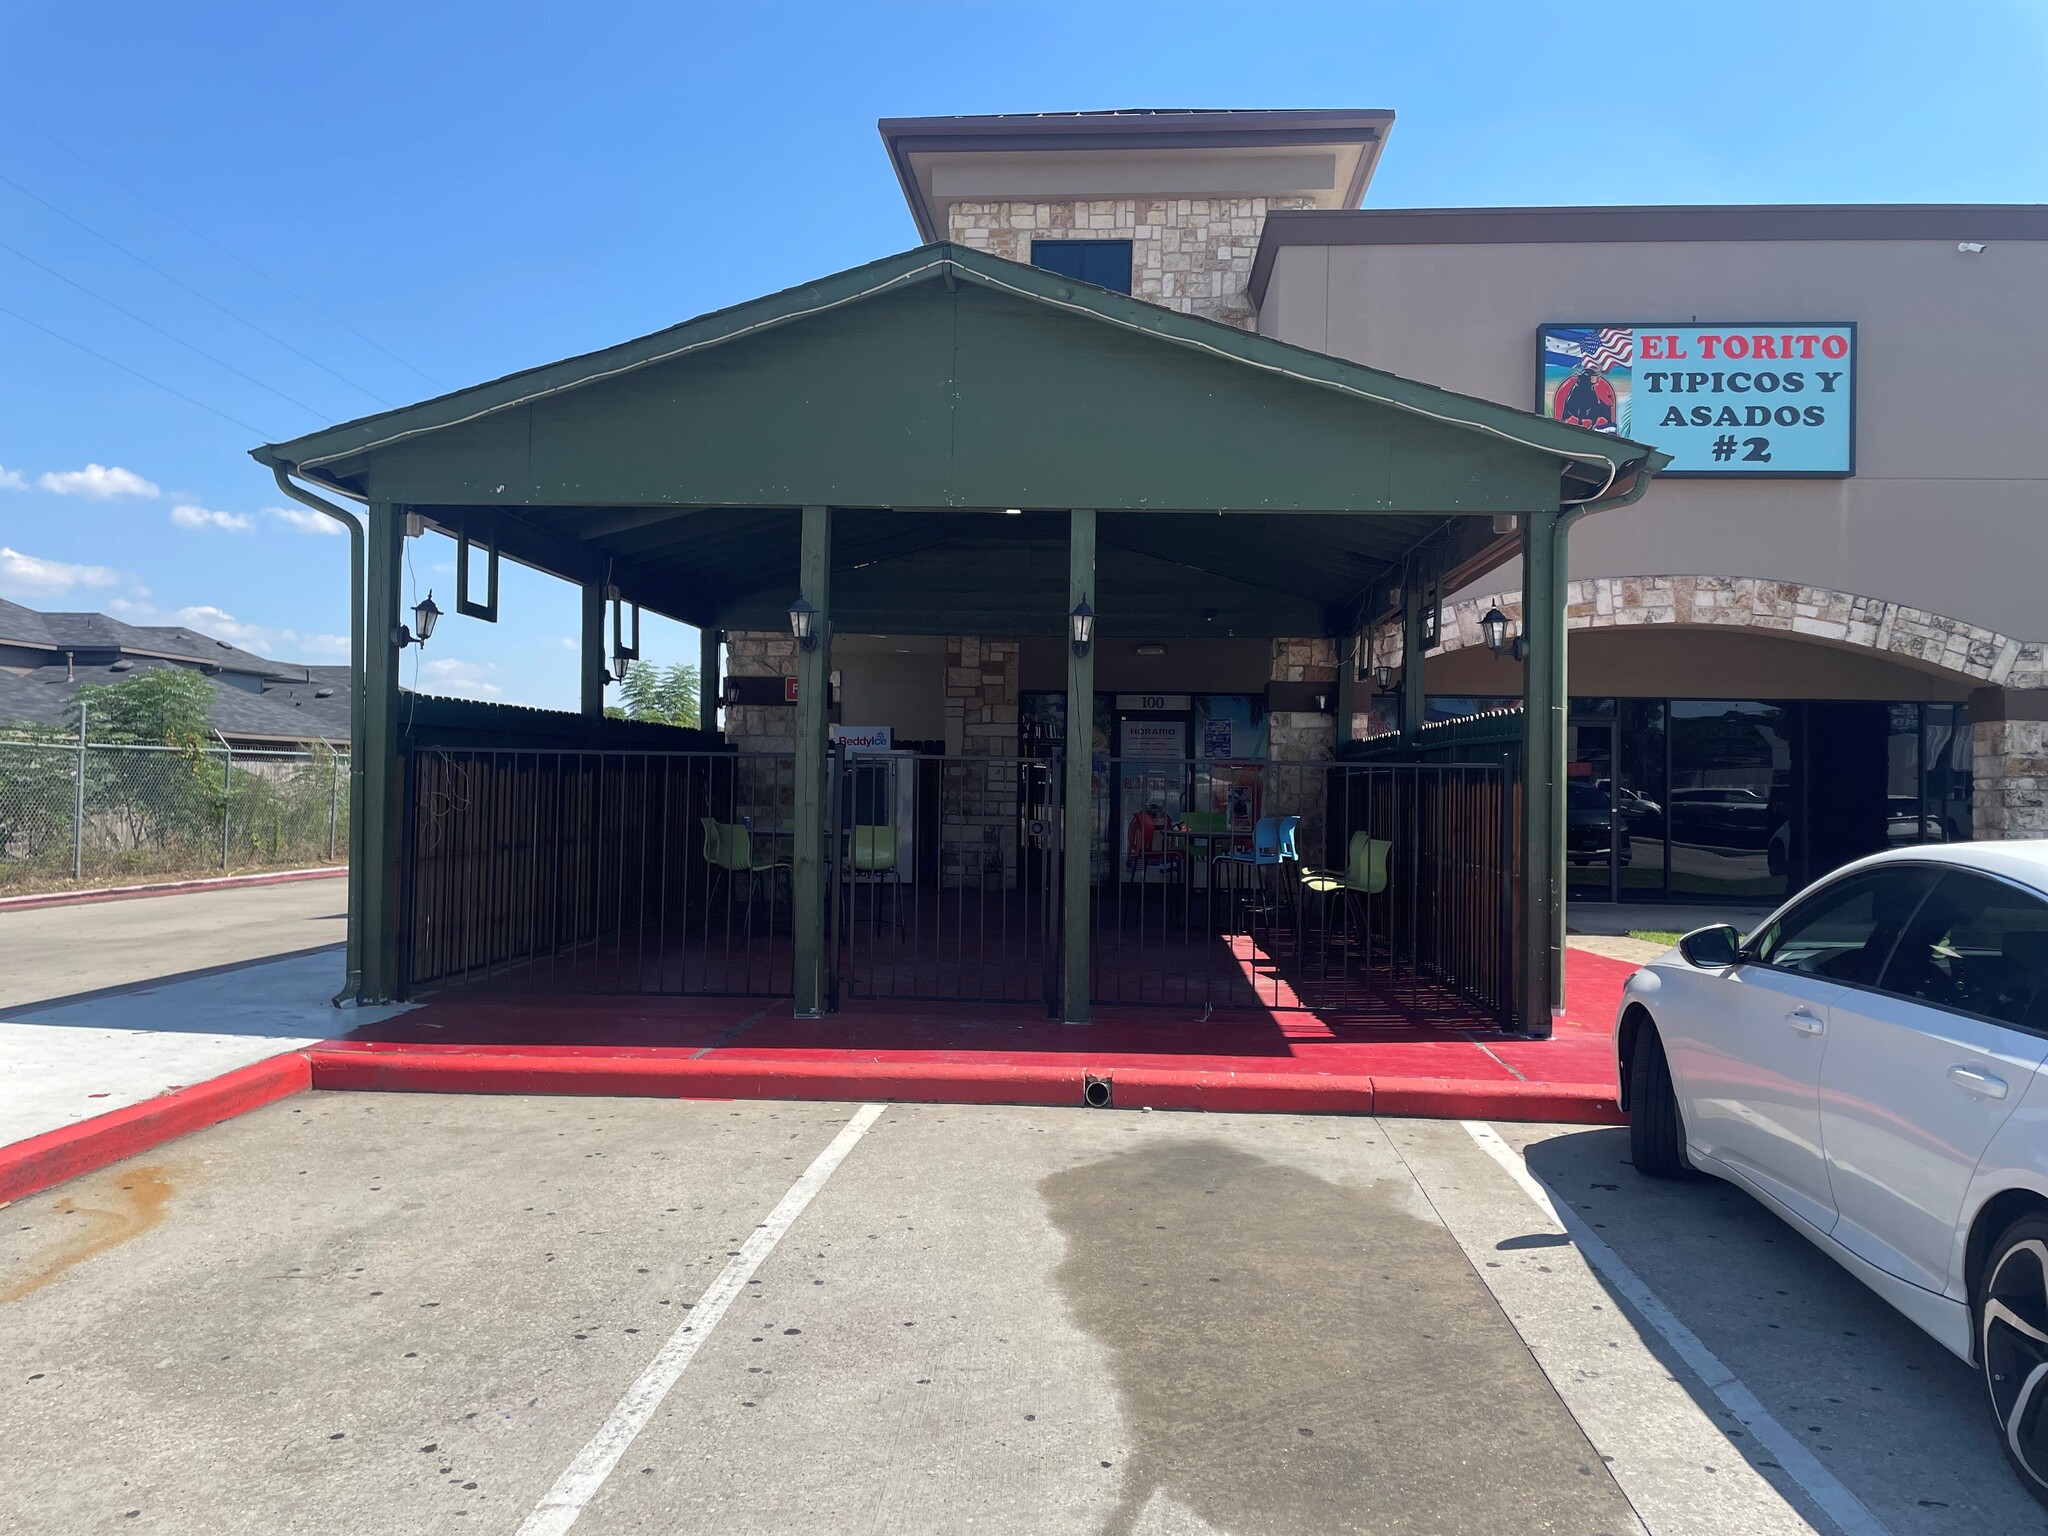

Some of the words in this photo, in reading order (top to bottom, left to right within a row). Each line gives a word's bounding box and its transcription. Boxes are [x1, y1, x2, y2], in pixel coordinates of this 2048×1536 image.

[1640, 335, 1688, 360] EL
[1696, 335, 1849, 360] TORITO
[1643, 371, 1806, 394] TIPICOS
[1815, 371, 1843, 393] Y
[1659, 405, 1826, 427] ASADOS
[1711, 434, 1772, 464] #2
[1142, 697, 1164, 709] 100
[1130, 728, 1175, 736] HORARIO
